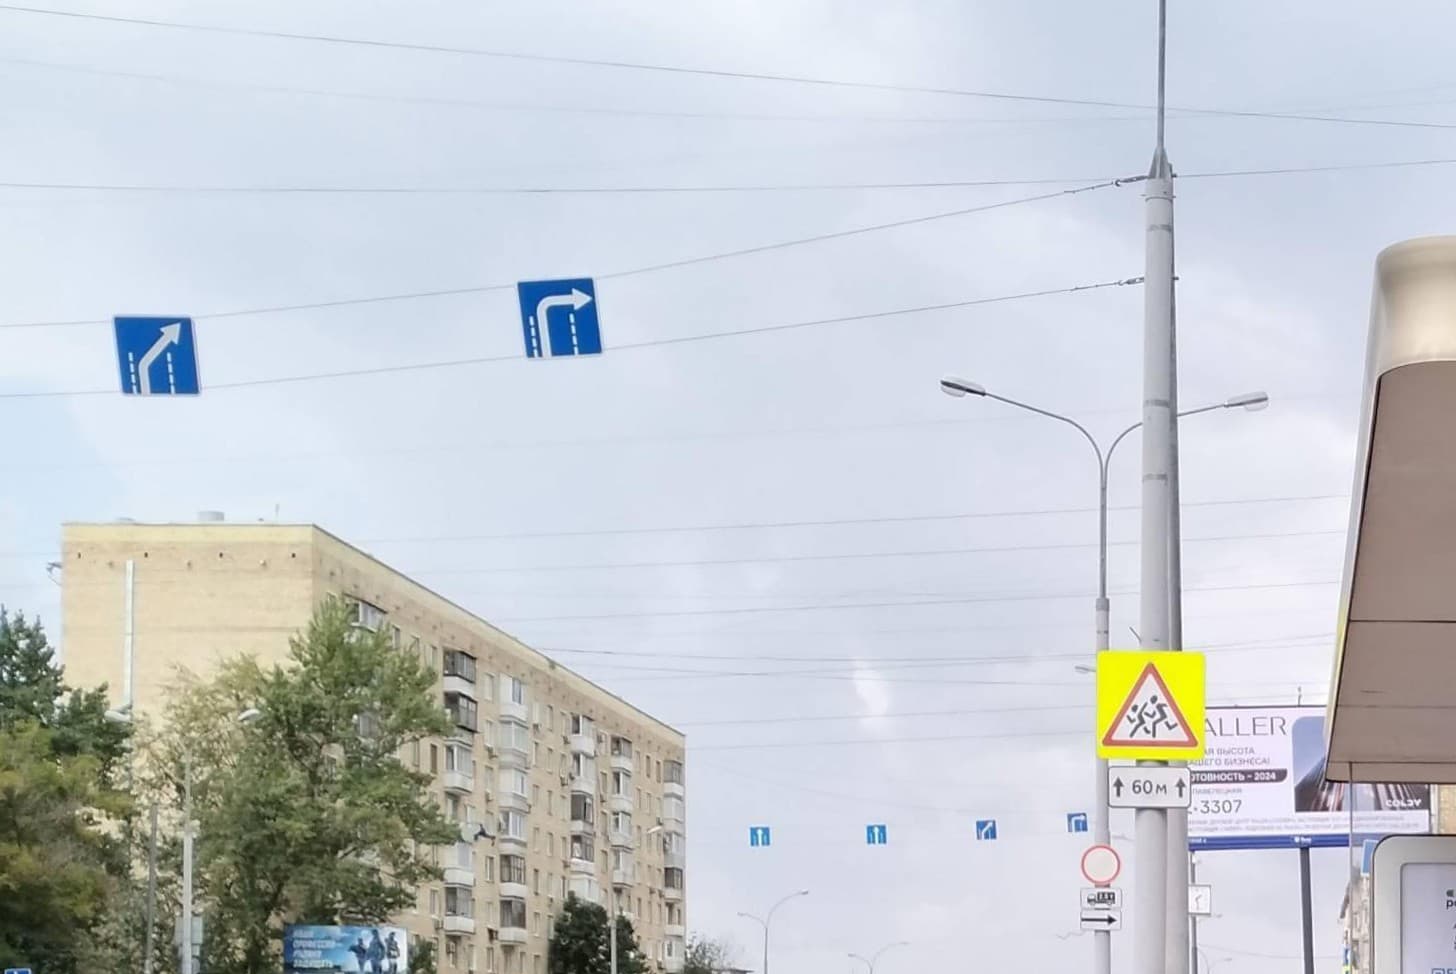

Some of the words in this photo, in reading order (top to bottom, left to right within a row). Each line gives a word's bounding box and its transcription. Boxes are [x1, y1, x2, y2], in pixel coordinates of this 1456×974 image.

[1205, 717, 1287, 736] ALLER
[1191, 773, 1245, 782] ОТОВНОСТЬ
[1254, 772, 1276, 781] 2024
[1132, 780, 1153, 794] 60
